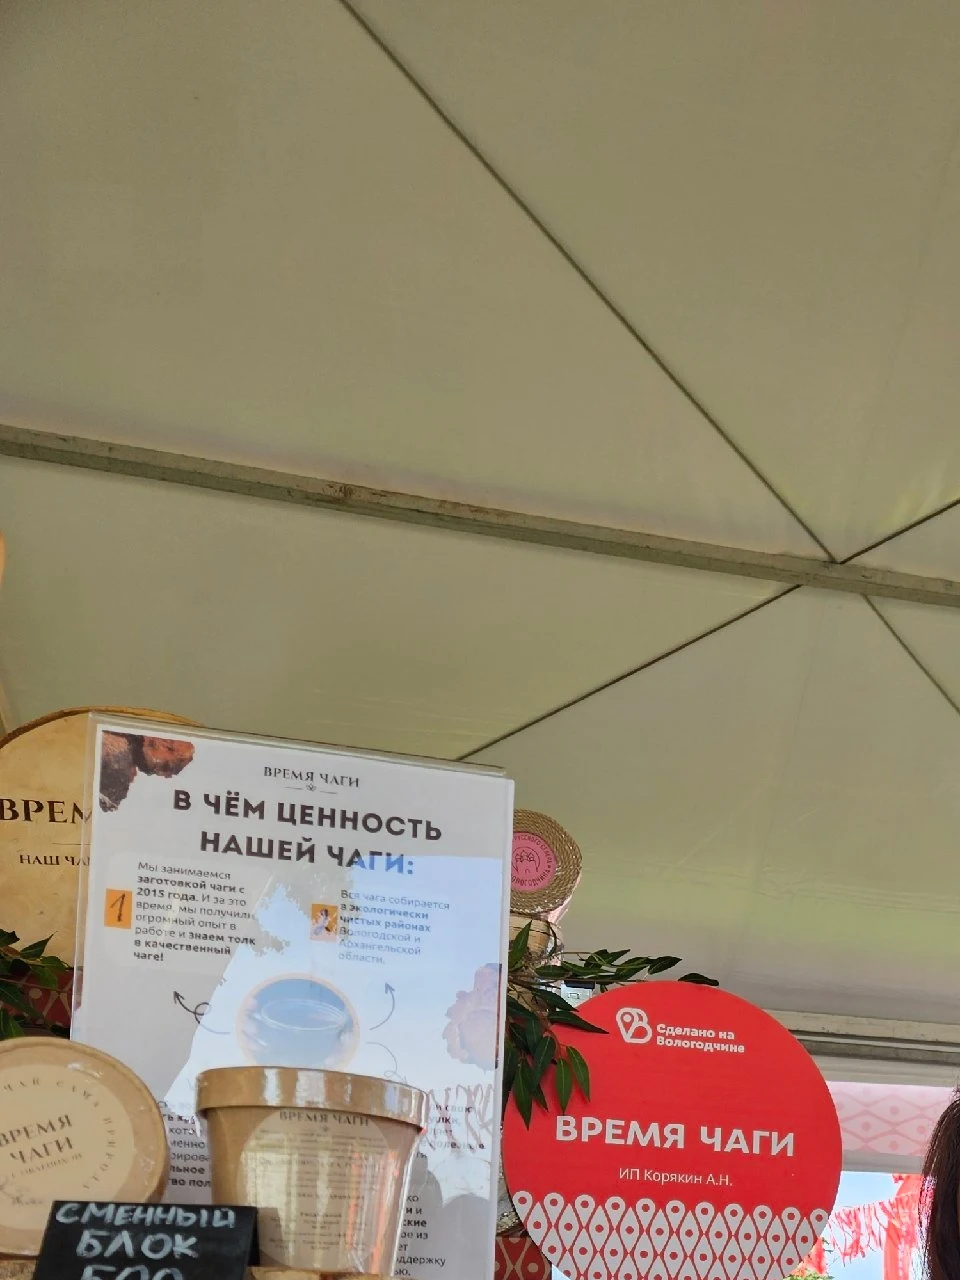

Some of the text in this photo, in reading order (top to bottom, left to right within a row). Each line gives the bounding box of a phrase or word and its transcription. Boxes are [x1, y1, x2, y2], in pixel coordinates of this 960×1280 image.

[264, 766, 359, 788] ВРЕМЯ ЧАГИ
[0, 798, 92, 824] ВРЕМ
[173, 789, 442, 841] В ЧЁМ ЦЕННОСТЬ
[19, 854, 60, 866] НАШ
[200, 831, 414, 875] НАШЕЙ ЧАГИ:
[137, 861, 231, 881] Мы занимаемся
[136, 875, 246, 895] заготовкой чаги с
[136, 887, 247, 908] 2015 года. И за это
[340, 889, 450, 910] Вся чага собирается
[110, 893, 126, 923] 1
[178, 906, 198, 915] мы
[349, 903, 429, 920] экологически
[135, 914, 237, 931] огромный опыт в
[339, 915, 431, 933] чистых районах
[178, 931, 187, 939] и
[188, 931, 225, 943] знаем
[227, 936, 256, 946] толк
[339, 926, 421, 944] Вологодской и
[133, 938, 231, 956] в качественный
[133, 950, 164, 962] чаге!
[338, 938, 421, 956] Архангельской
[656, 1023, 735, 1041] Сделано на
[656, 1036, 745, 1054] Вологодчине
[556, 1115, 795, 1157] ВРЕМЯ ЧАГИ
[9, 1136, 74, 1165] ЧАГИ
[618, 1167, 734, 1187] ИП Корякин А.Н.
[55, 1202, 236, 1229] СМЕННЫЙ
[75, 1228, 199, 1260] БЛОК
